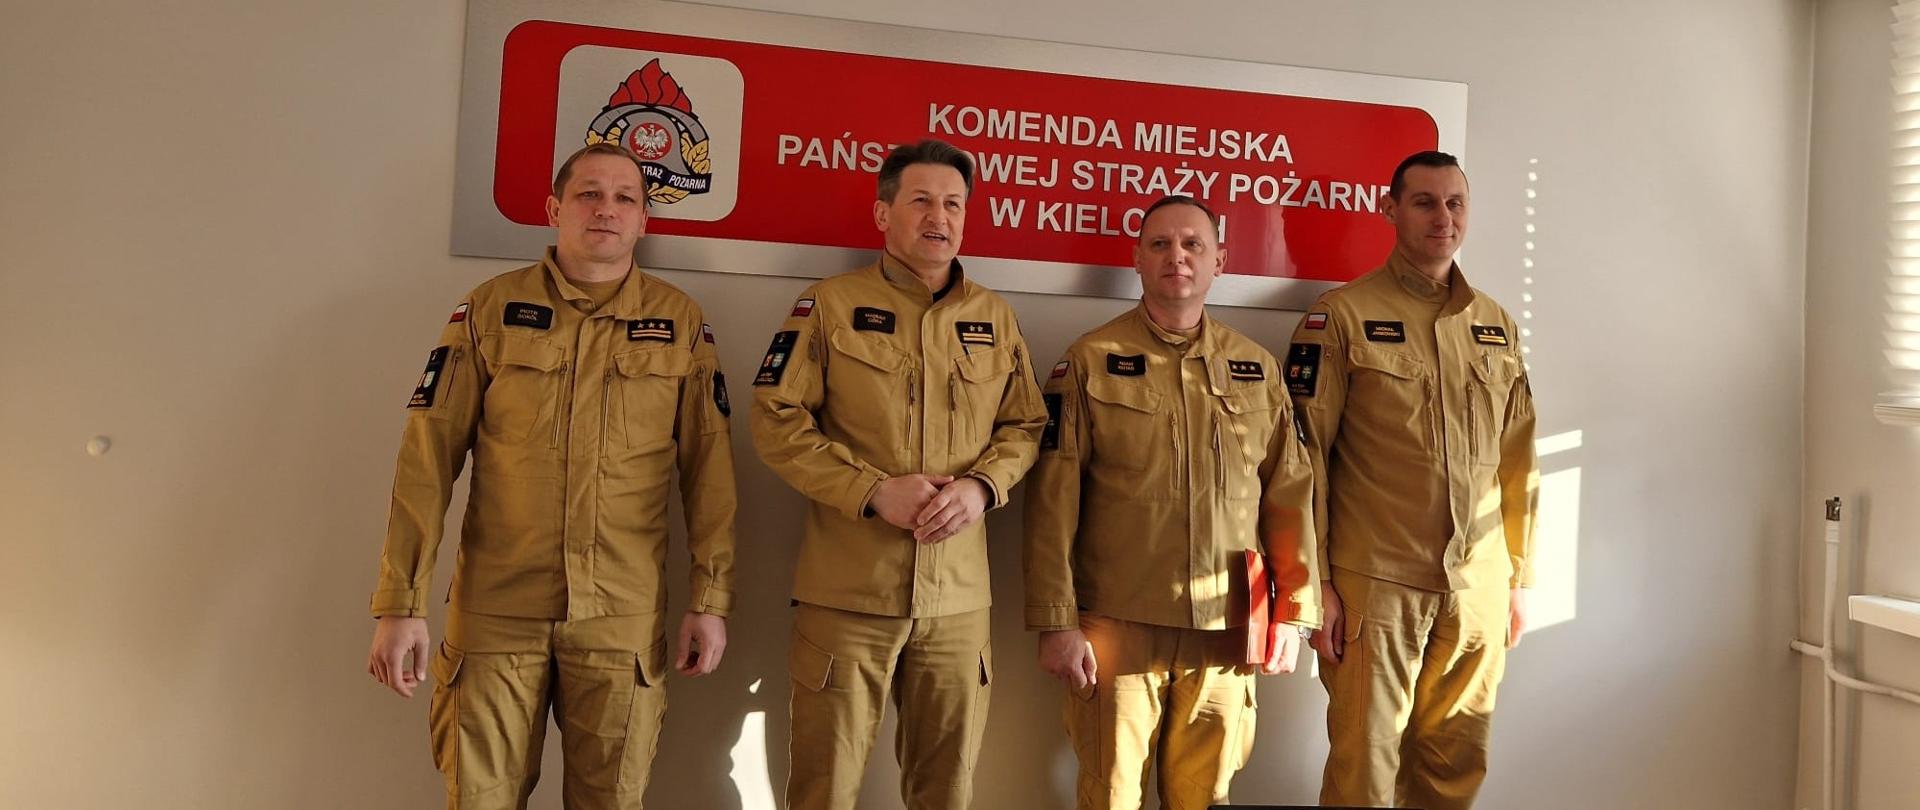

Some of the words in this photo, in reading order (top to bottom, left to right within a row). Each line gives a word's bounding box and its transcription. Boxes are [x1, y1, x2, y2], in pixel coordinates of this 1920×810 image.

[928, 102, 1123, 150] KOMENDA
[1134, 121, 1294, 164] MIEJSKA
[641, 165, 663, 179] TRAŻ
[777, 131, 1059, 188] PAŃSWEJ
[1071, 160, 1220, 200] STRAŻY
[1229, 170, 1391, 214] POŻARN
[989, 196, 1026, 229] W
[1037, 200, 1227, 244] KIELC
